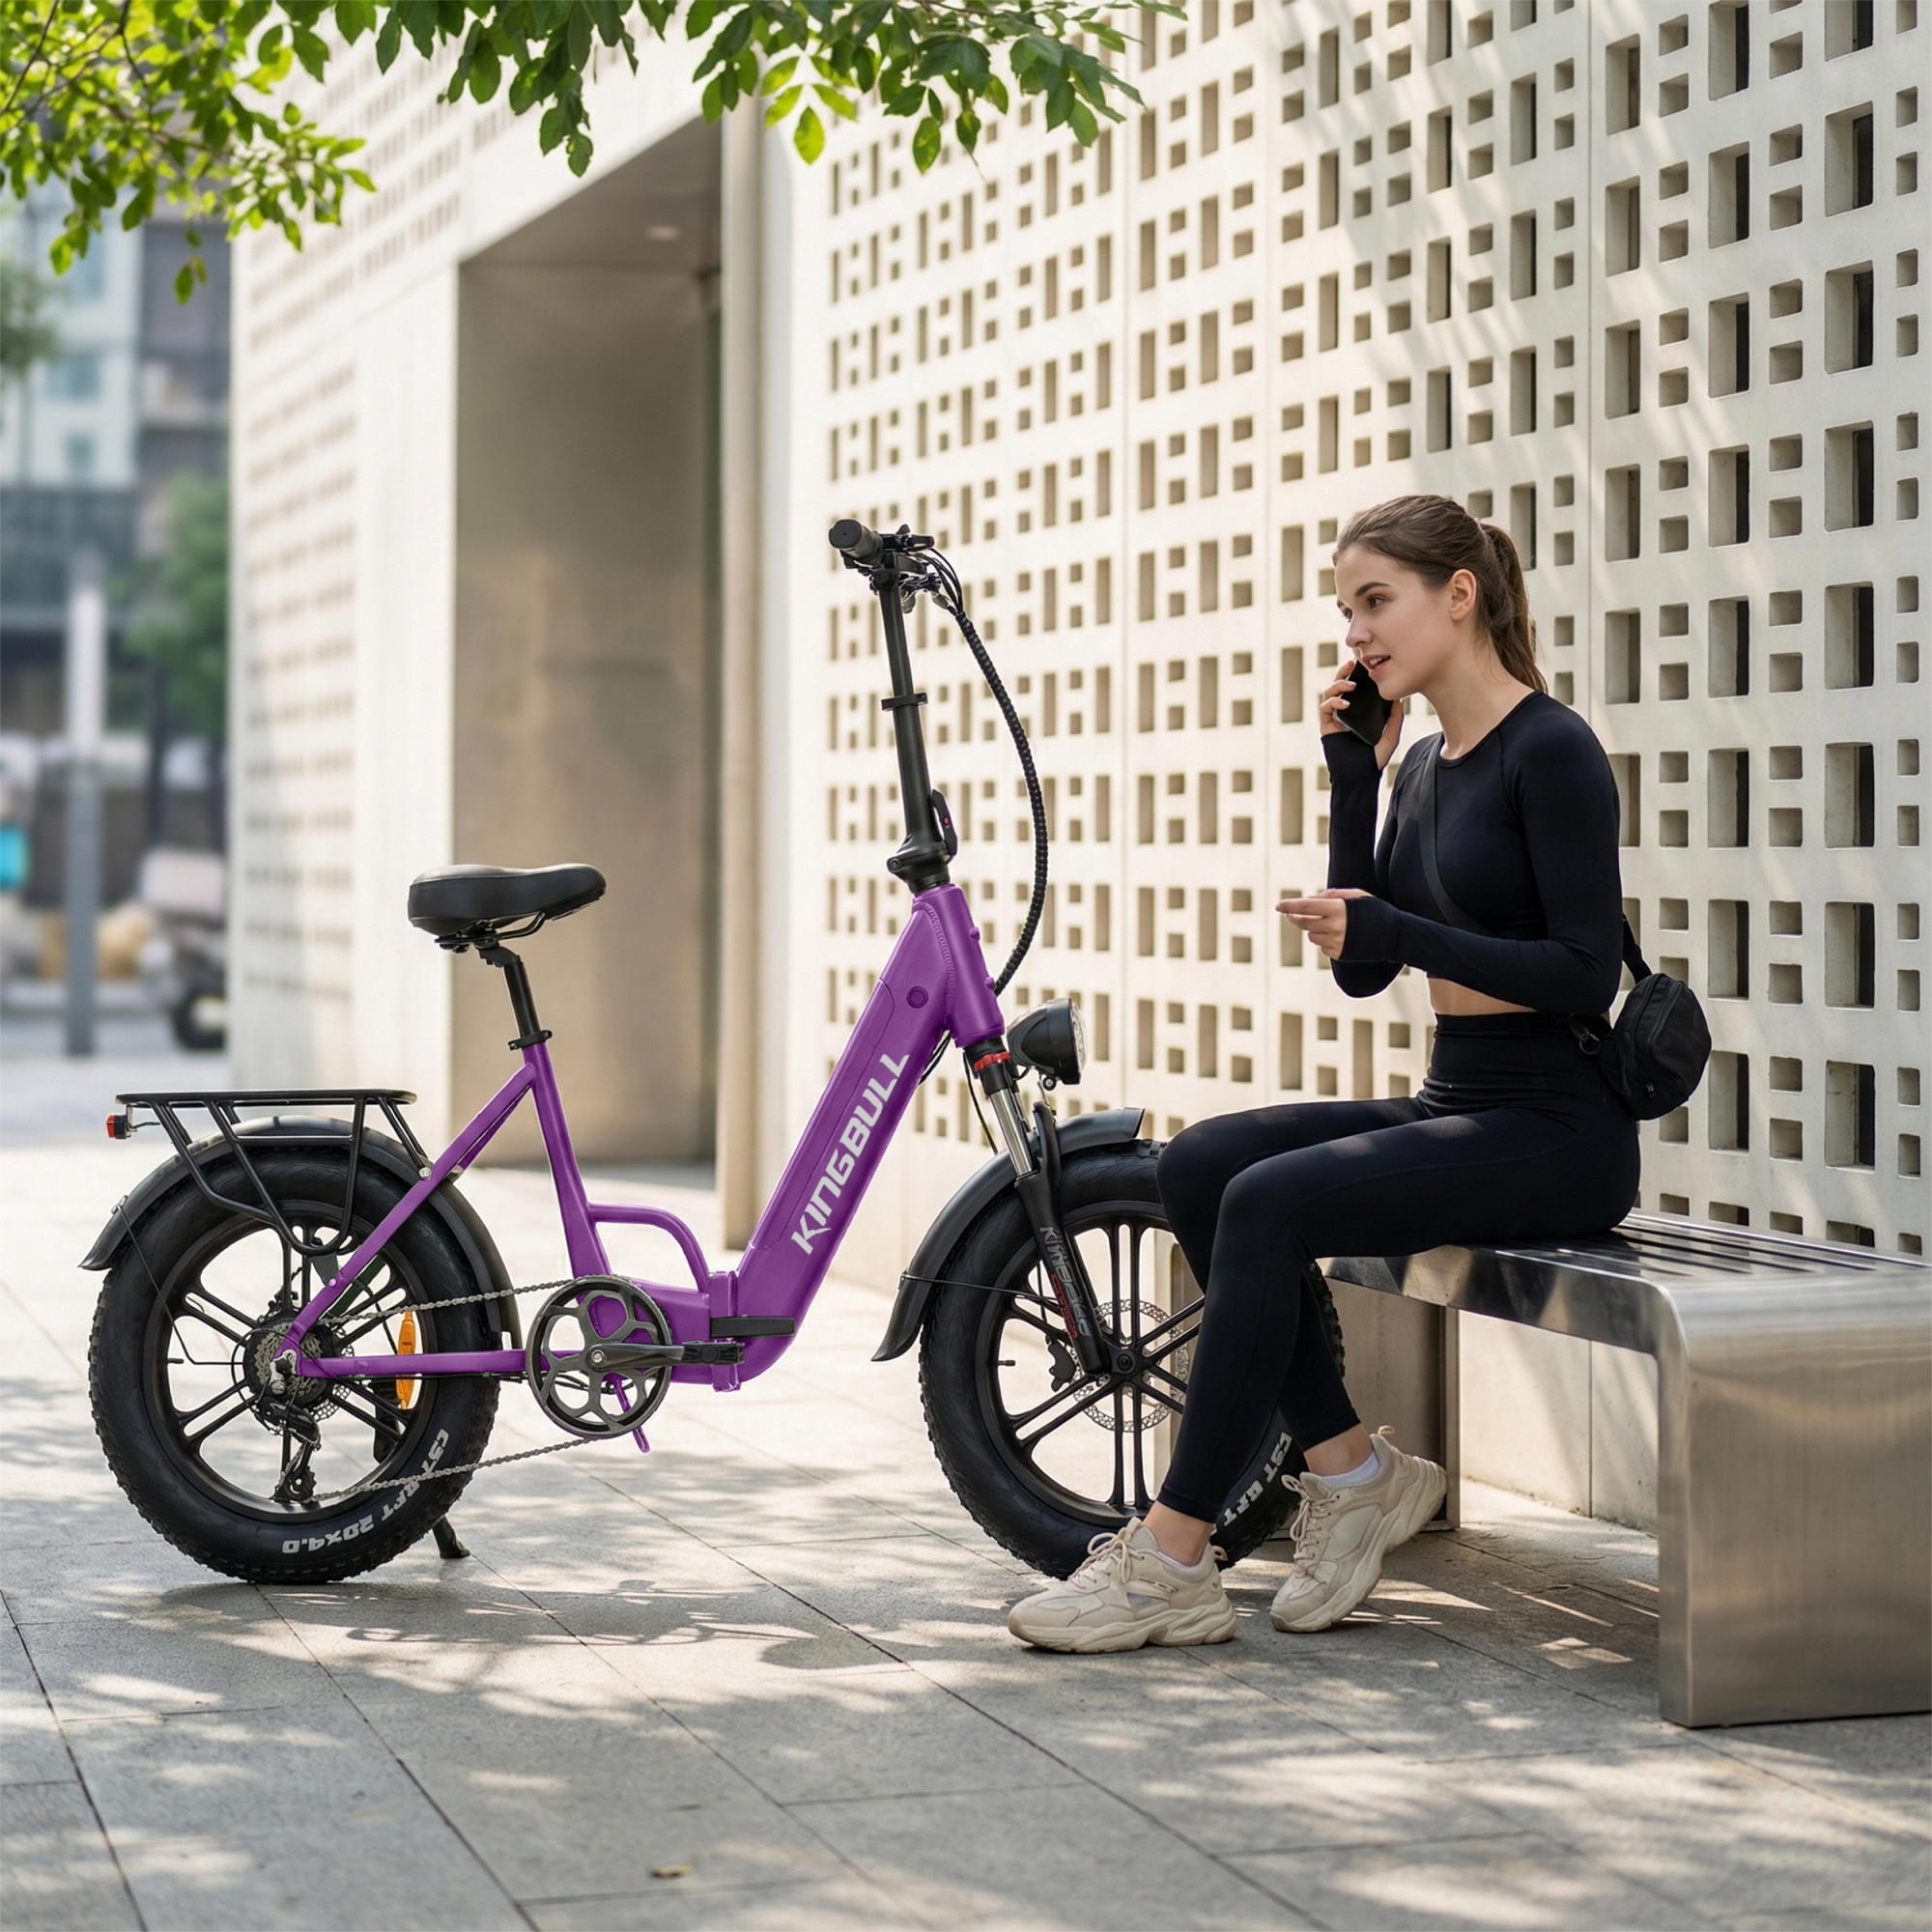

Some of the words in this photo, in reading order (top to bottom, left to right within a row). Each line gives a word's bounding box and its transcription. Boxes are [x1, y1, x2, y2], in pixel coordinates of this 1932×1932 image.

[791, 1054, 910, 1255] KINGBULL
[421, 1429, 449, 1478] CST
[1264, 1432, 1293, 1483] CST
